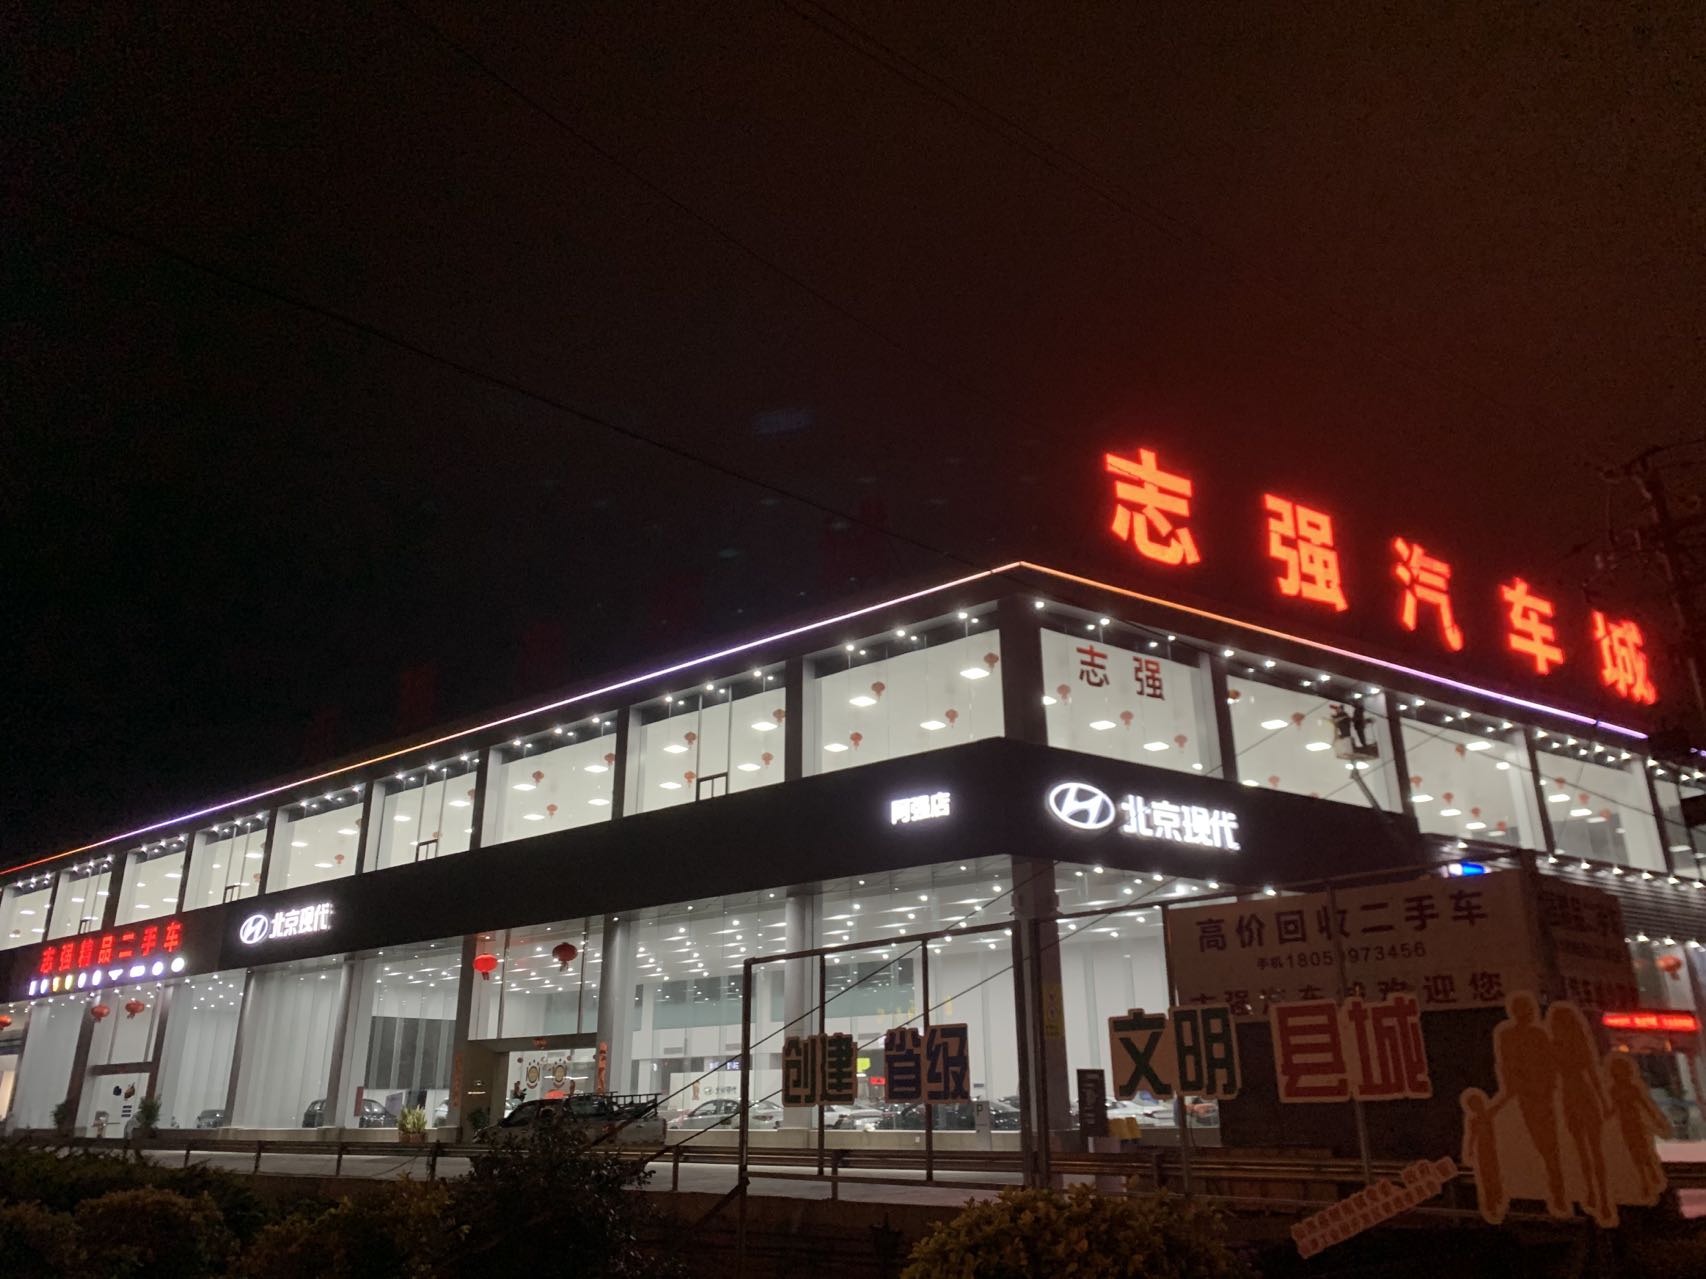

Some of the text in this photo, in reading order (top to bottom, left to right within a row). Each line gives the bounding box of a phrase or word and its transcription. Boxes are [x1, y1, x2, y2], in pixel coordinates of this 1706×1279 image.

[1104, 448, 1658, 705] 志强汽车城
[1076, 645, 1165, 701] 志强
[1120, 794, 1240, 850] 北京现代
[268, 902, 334, 939] 北京现代
[1195, 889, 1488, 952] 高价回收二手车
[1286, 941, 1426, 968] 1805973456
[1113, 1006, 1238, 1096] 文明
